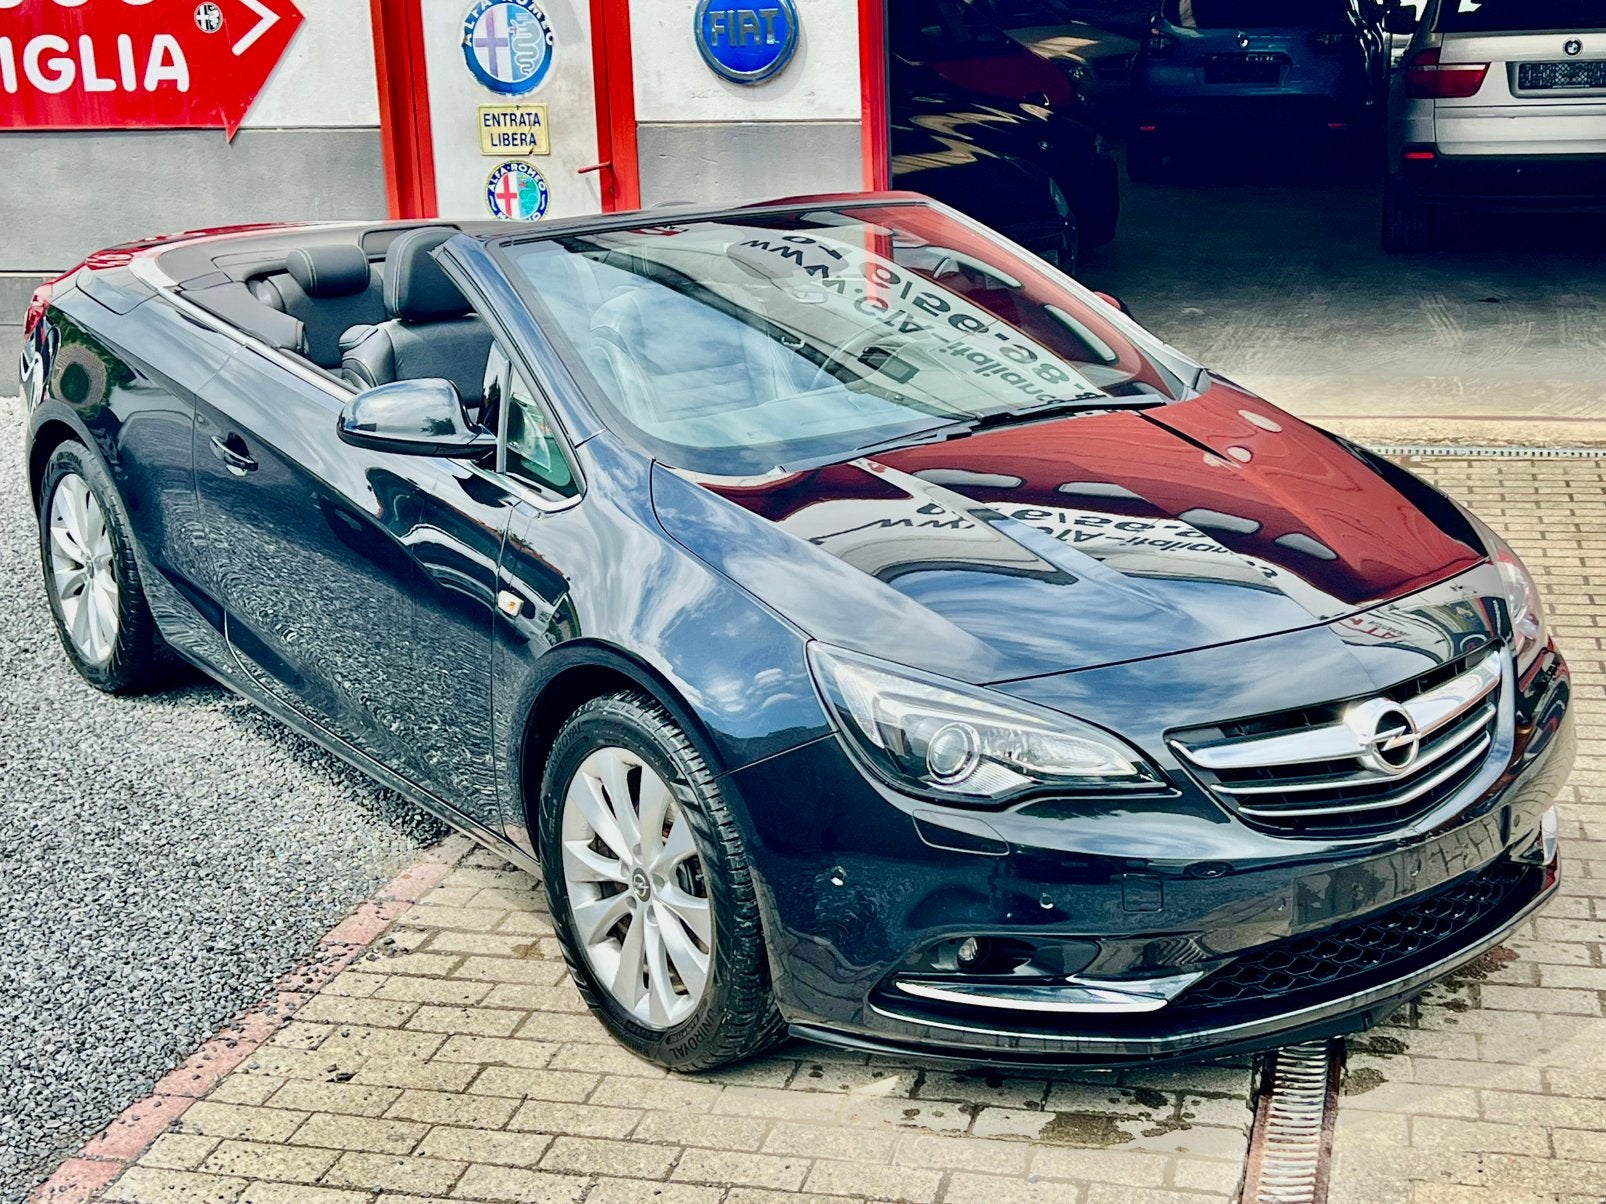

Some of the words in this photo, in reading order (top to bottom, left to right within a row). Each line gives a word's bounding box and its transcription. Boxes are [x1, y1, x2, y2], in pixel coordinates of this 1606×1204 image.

[462, 0, 493, 47] ALFA
[505, 0, 555, 46] OMEO
[709, 8, 779, 47] FIAT
[483, 112, 541, 127] ENTRATA
[490, 132, 537, 147] LIBERA
[510, 163, 547, 192] ROMEO
[668, 1008, 716, 1060] UNIROYAL
